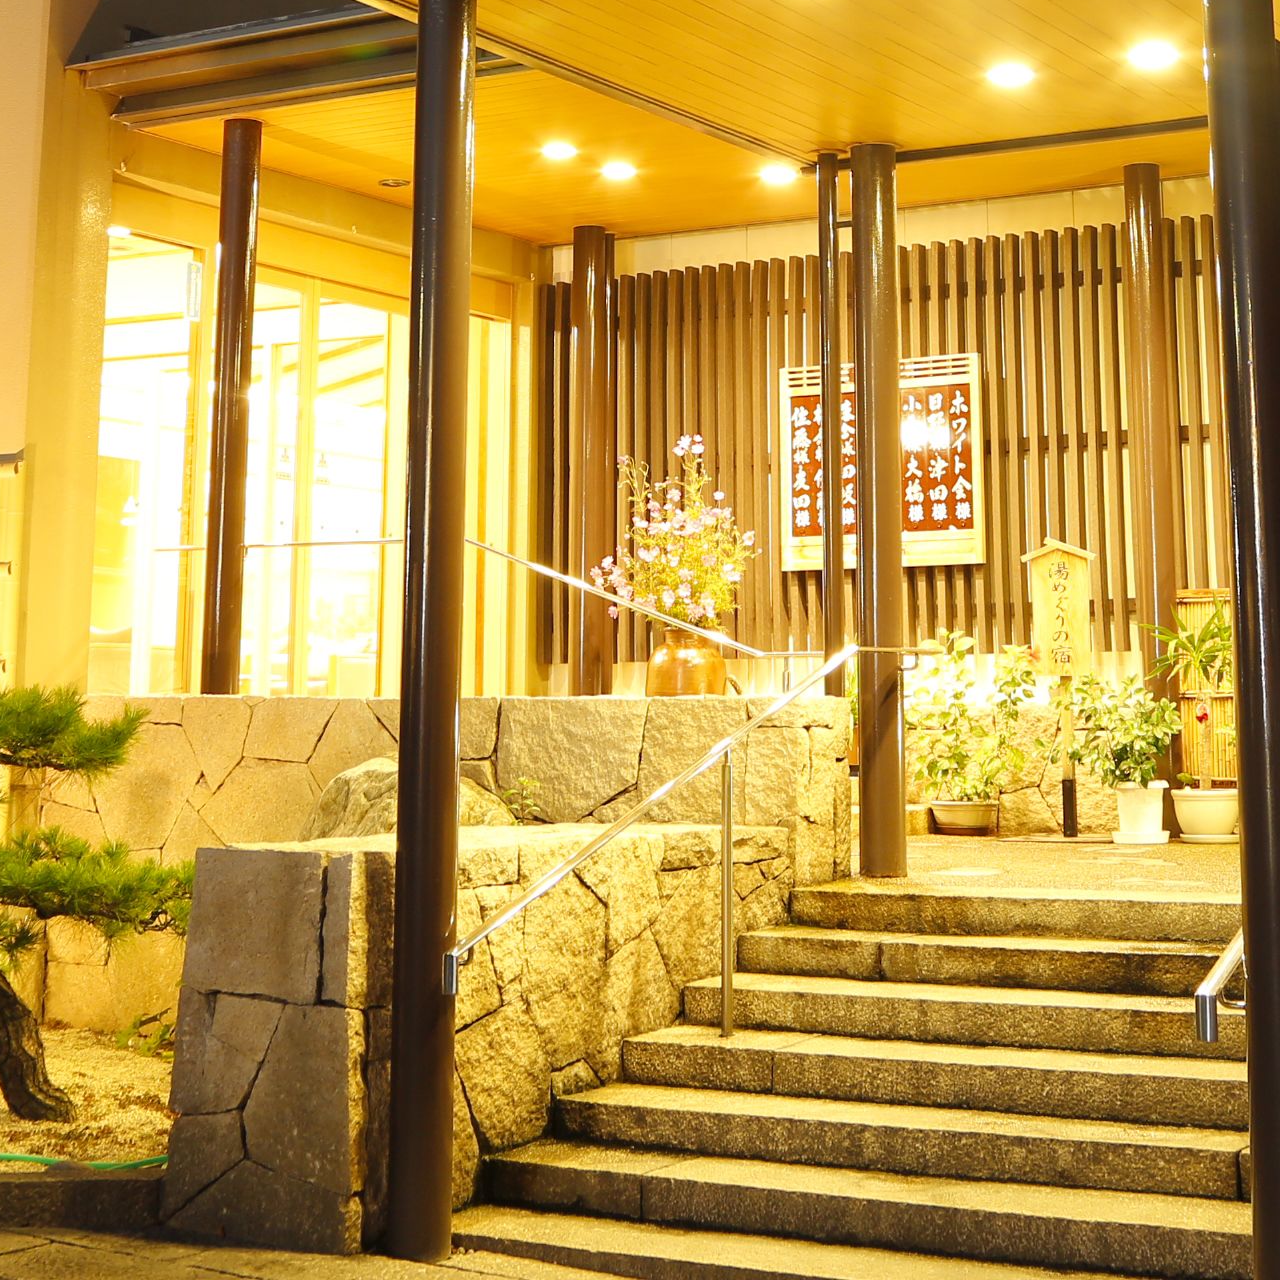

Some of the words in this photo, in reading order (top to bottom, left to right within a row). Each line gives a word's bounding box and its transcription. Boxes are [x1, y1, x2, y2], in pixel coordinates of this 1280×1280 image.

[1048, 562, 1073, 664] 湯めぐりの宿
